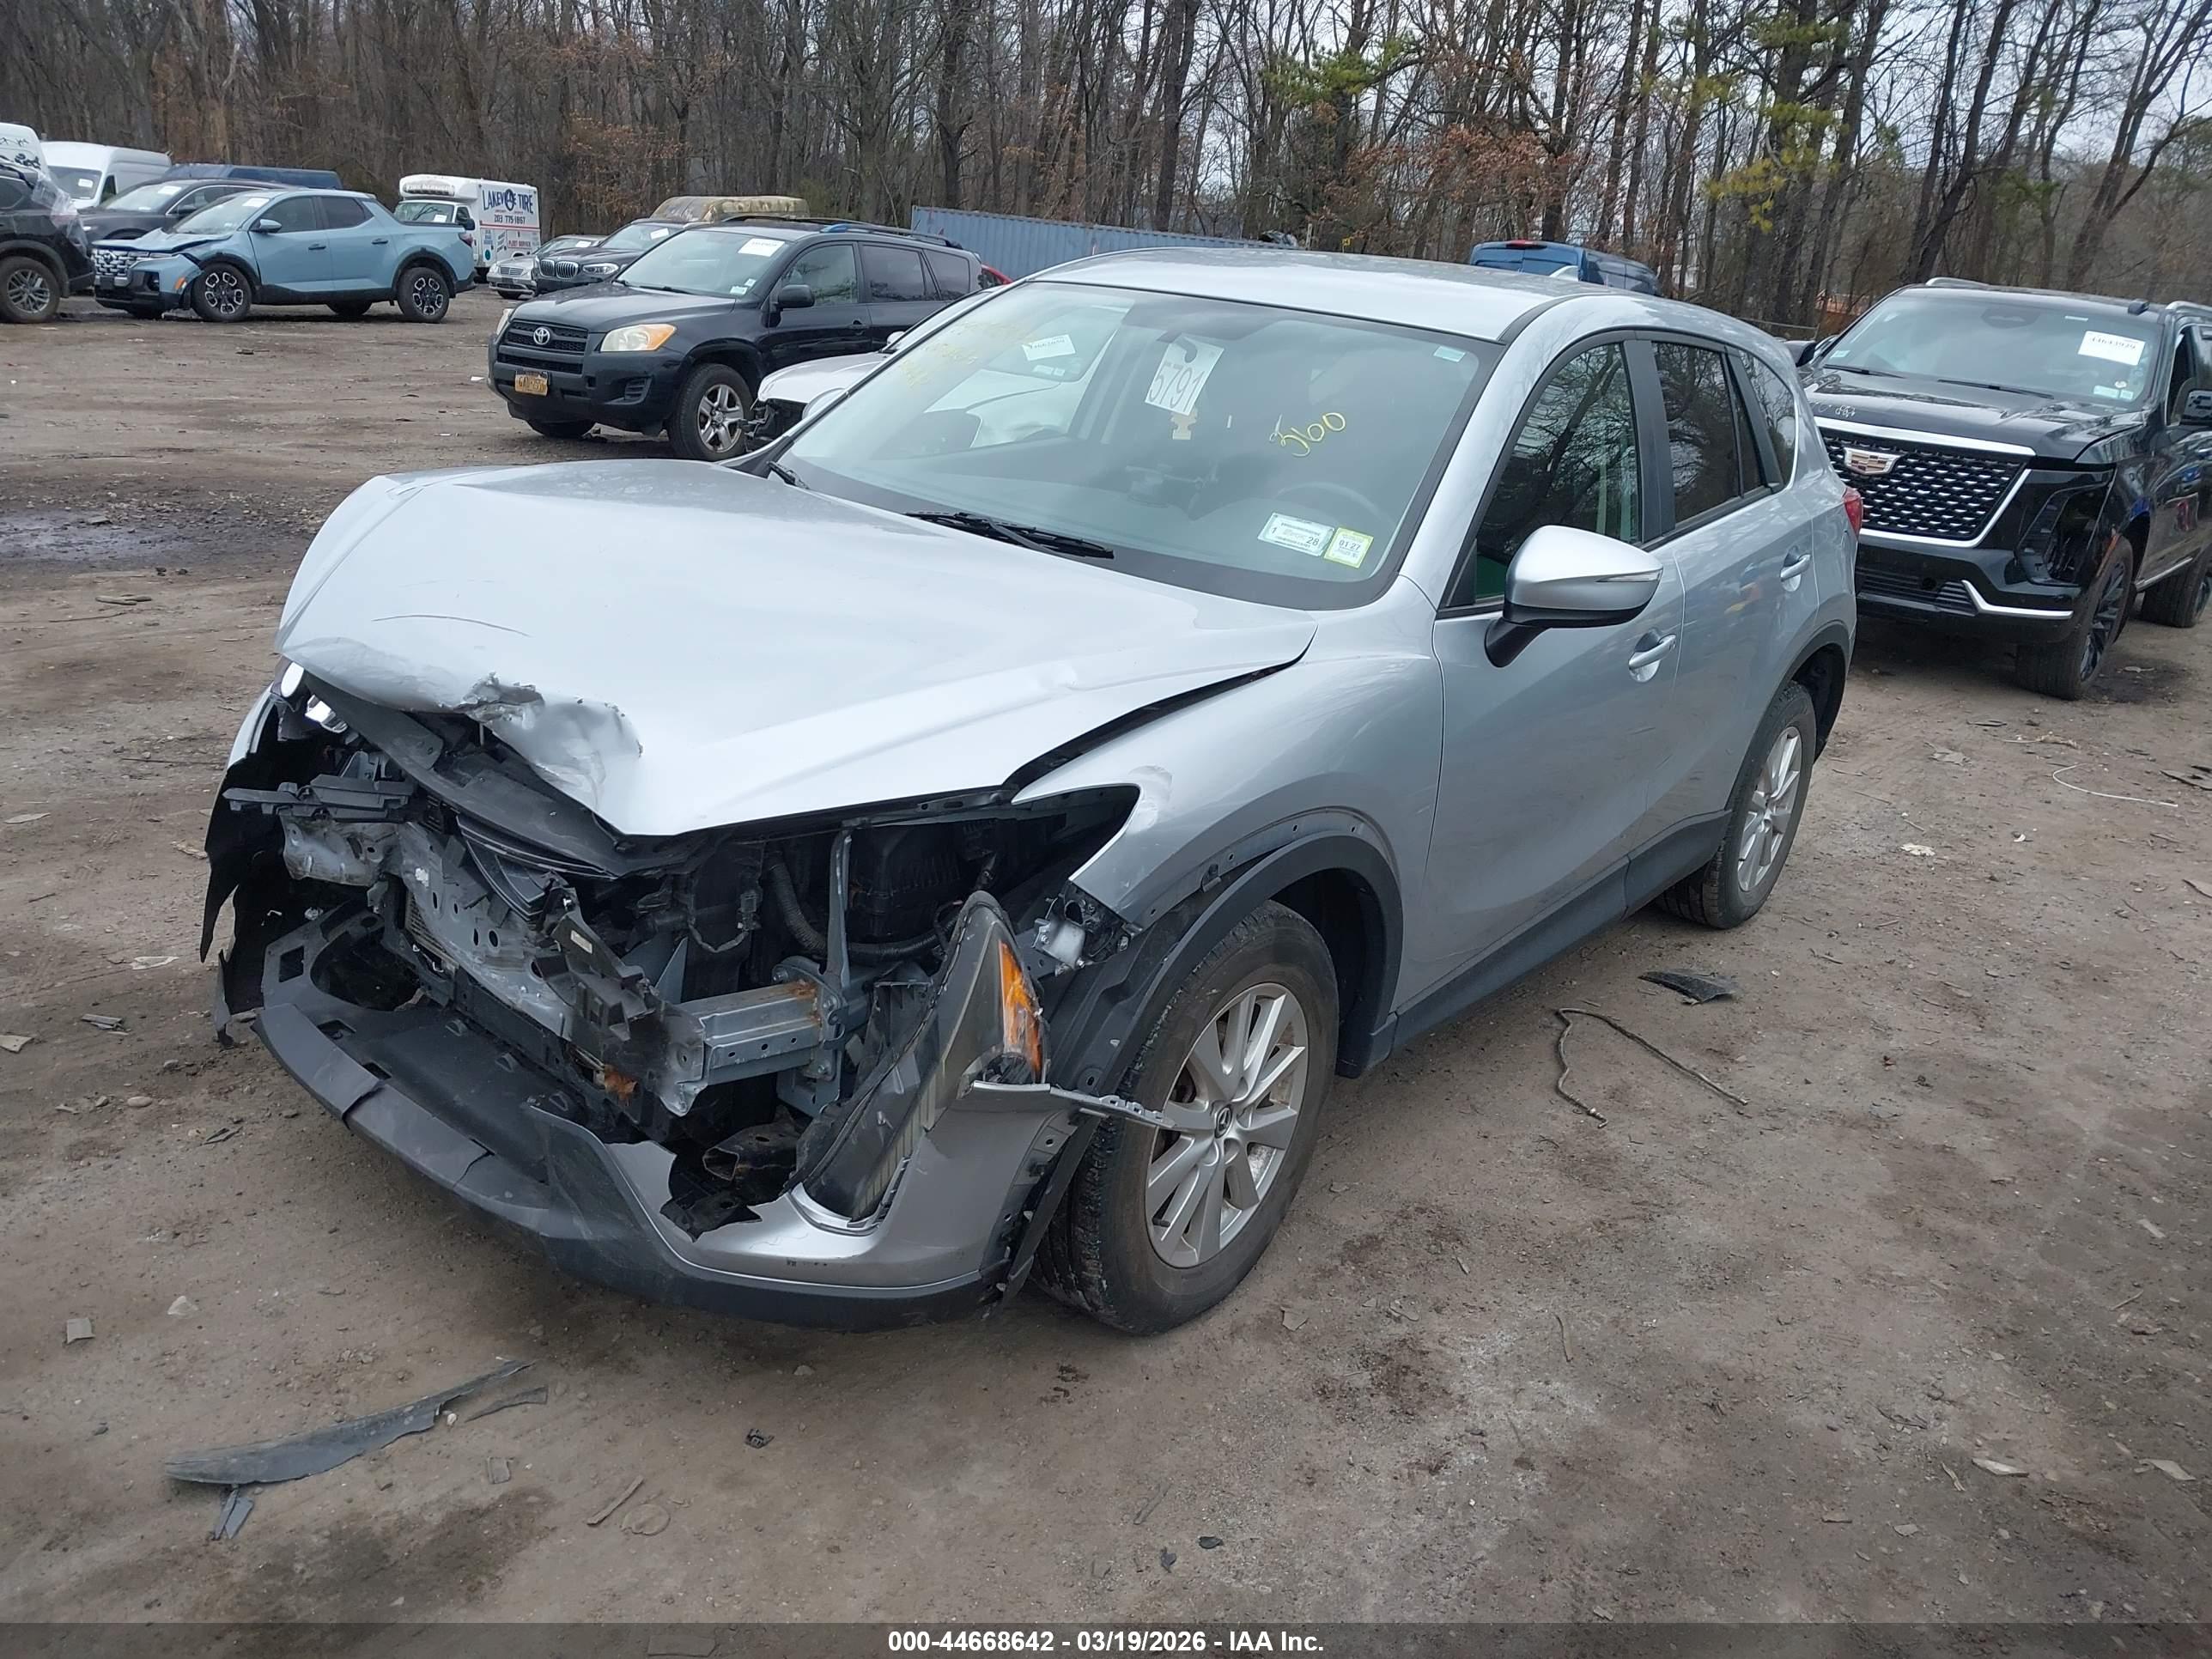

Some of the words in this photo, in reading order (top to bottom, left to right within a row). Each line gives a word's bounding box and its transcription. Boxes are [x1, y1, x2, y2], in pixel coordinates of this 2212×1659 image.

[518, 193, 534, 214] TIRE
[1149, 362, 1205, 412] 5791
[1306, 537, 1320, 546] 28
